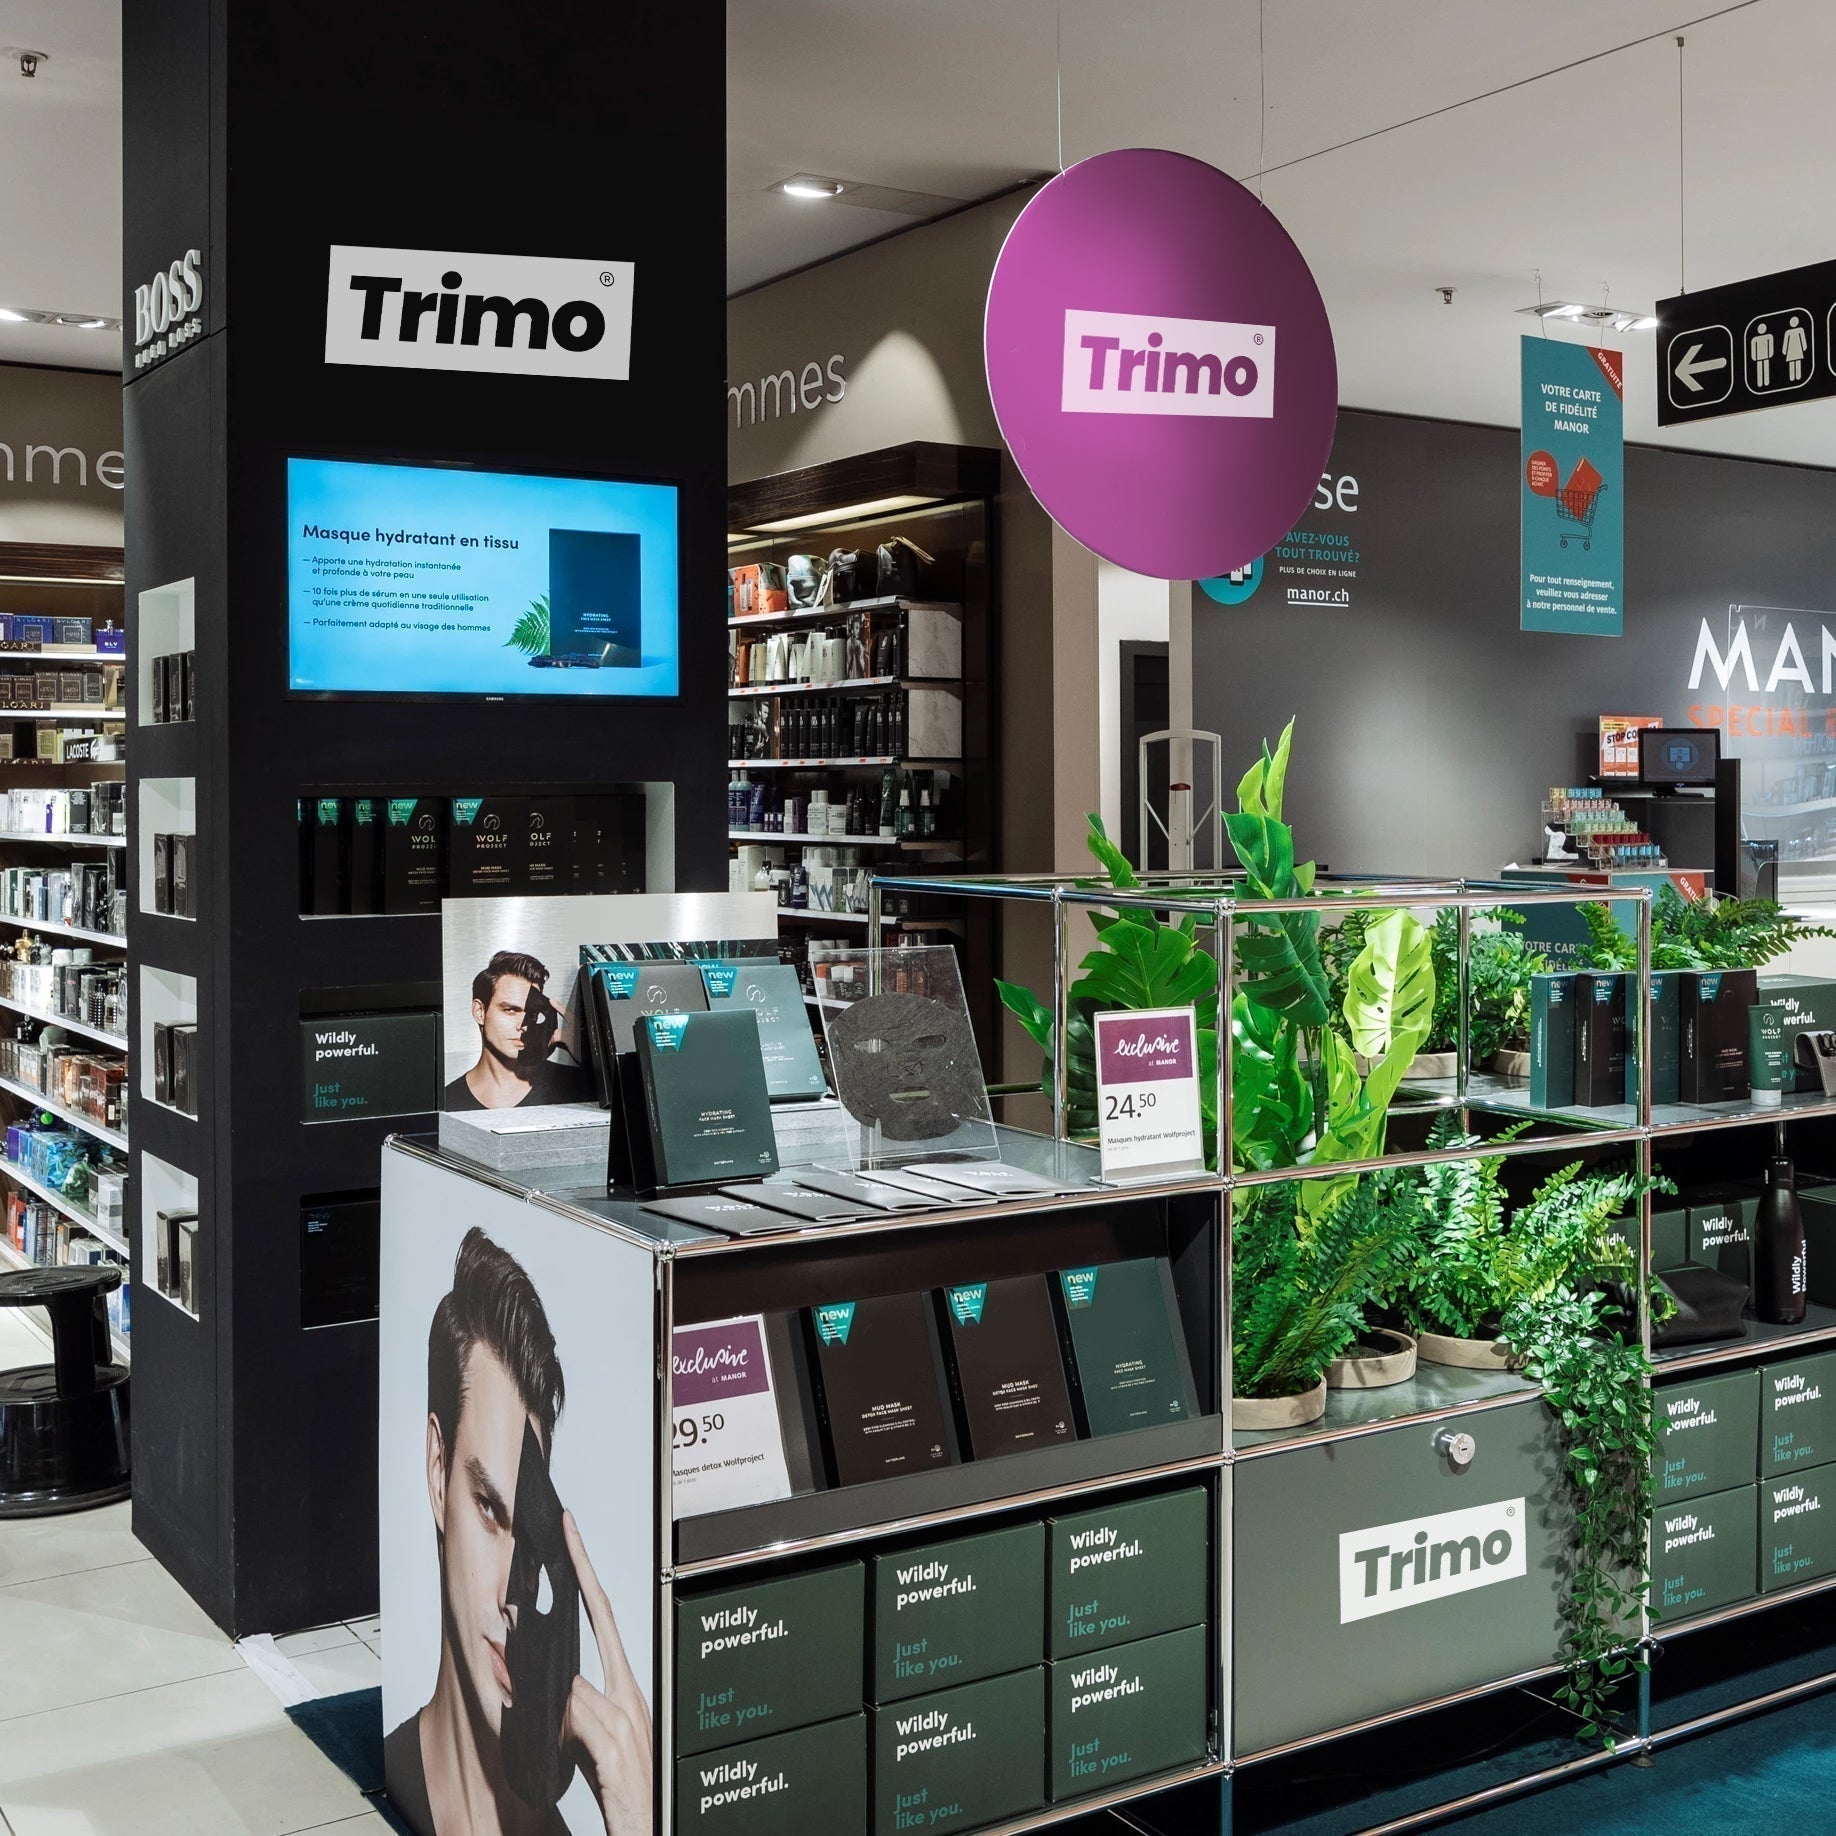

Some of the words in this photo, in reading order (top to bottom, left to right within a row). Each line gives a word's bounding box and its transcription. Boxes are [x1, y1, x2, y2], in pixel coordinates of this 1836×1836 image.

[135, 249, 202, 346] BOSS
[350, 270, 605, 353] Trimo
[1081, 332, 1258, 396] Trimo
[1597, 352, 1623, 389] GRATUITE
[1541, 383, 1571, 398] VOTRE
[1573, 388, 1602, 402] CARTE
[1545, 401, 1558, 413] DE
[1560, 403, 1598, 419] FIDÉLITÉ
[1554, 419, 1589, 434] MANOR
[303, 524, 371, 545] Masque
[375, 528, 456, 546] hydratant
[460, 537, 479, 547] en
[484, 535, 519, 549] tissu
[1286, 532, 1350, 547] AVEZ-VOUS
[311, 556, 346, 566] Apporte
[366, 558, 412, 569] hydratation
[414, 561, 461, 571] instantanée
[1275, 547, 1306, 559] TOUT
[1308, 549, 1360, 563] TROUVÉ?
[312, 567, 320, 575] et
[322, 567, 361, 577] profonde
[363, 568, 369, 577] à
[370, 570, 391, 578] votre
[1307, 568, 1326, 576] CHOIX
[1530, 574, 1546, 583] Pour
[1547, 576, 1562, 584] tout
[1563, 578, 1615, 590] renseignement,
[312, 587, 321, 596] 10
[323, 587, 338, 596] fois
[340, 588, 357, 598] plus
[359, 589, 370, 597] de
[371, 590, 398, 599] sérum
[411, 592, 427, 600] une
[428, 592, 450, 600] seule
[451, 593, 489, 602] utilisation
[1287, 588, 1350, 602] manor.ch
[1536, 588, 1562, 597] veuillez
[1564, 591, 1579, 599] vous
[1581, 591, 1608, 601] adresser
[312, 598, 342, 607] qu'une
[343, 599, 369, 608] crème
[371, 601, 420, 610] quotidienne
[421, 602, 474, 612] traditionnelle
[1527, 599, 1531, 608] à
[1532, 601, 1551, 609] notre
[1552, 602, 1585, 612] personnel
[1586, 604, 1595, 613] de
[1597, 606, 1617, 614] vente.
[312, 618, 367, 628] Parfaitement
[368, 620, 399, 631] adapté
[400, 622, 411, 630] au
[413, 622, 440, 632] visage
[441, 623, 456, 631] des
[457, 623, 491, 632] hommes
[1687, 704, 1813, 737] SPECIAL
[1607, 730, 1626, 744] STOP
[66, 743, 89, 759] LACOSTE
[391, 802, 413, 810] new
[475, 834, 508, 843] WOLF
[607, 971, 635, 980] new
[708, 971, 733, 980] new
[1701, 978, 1718, 986] new
[653, 1018, 685, 1030] new
[1783, 1011, 1816, 1026] werful.
[315, 1031, 357, 1046] Wildly
[1114, 1033, 1180, 1058] exclusive
[315, 1043, 379, 1061] powerful.
[1156, 1058, 1177, 1066] MANOR
[313, 1082, 341, 1097] Just
[314, 1095, 338, 1109] like
[340, 1096, 369, 1110] you.
[1105, 1092, 1157, 1120] 24.50
[1107, 1136, 1133, 1145] Masques
[1133, 1132, 1162, 1142] hydratant
[1163, 1129, 1196, 1140] Wolfproject
[1702, 1216, 1733, 1232] Wildly
[1702, 1228, 1749, 1250] powerful.
[1067, 1272, 1094, 1284] new
[1792, 1256, 1802, 1294] Wildly
[954, 1289, 982, 1302] new
[819, 1308, 849, 1321] new
[672, 1345, 749, 1375] exclusive
[1115, 1360, 1143, 1369] HYDRATING
[720, 1371, 747, 1382] MANOR
[1774, 1374, 1805, 1392] Wildly
[886, 1402, 901, 1410] MASK
[1666, 1398, 1700, 1416] Wildly
[1774, 1386, 1821, 1411] powerful.
[1666, 1410, 1717, 1436] powerful.
[1773, 1432, 1793, 1451] Just
[701, 1461, 723, 1472] detox
[723, 1453, 765, 1468] Wolfproject
[1774, 1449, 1791, 1462] like
[1793, 1445, 1813, 1458] you.
[1663, 1457, 1686, 1477] Just
[1664, 1474, 1683, 1488] like
[1685, 1472, 1706, 1485] you.
[1773, 1485, 1804, 1504] Wildly
[1773, 1496, 1821, 1523] powerful.
[1665, 1515, 1698, 1533] Wildly
[1070, 1527, 1117, 1552] Wildly
[1665, 1525, 1715, 1553] powerful.
[1070, 1540, 1143, 1574] powerful.
[1354, 1529, 1512, 1598] Trimo
[896, 1561, 949, 1588] Wildly
[896, 1574, 976, 1611] powerful.
[1663, 1574, 1684, 1594] Just
[1663, 1591, 1682, 1607] like
[1684, 1588, 1706, 1602] you.
[700, 1606, 758, 1632] Wildly
[1066, 1599, 1099, 1624] Just
[1068, 1619, 1097, 1638] like
[1099, 1615, 1131, 1636] you.
[700, 1623, 789, 1659] powerful.
[893, 1637, 928, 1664] Just
[895, 1659, 925, 1679] like
[928, 1654, 963, 1677] you.
[1070, 1665, 1118, 1690] Wildly
[697, 1687, 735, 1716] Just
[1070, 1678, 1144, 1712] powerful.
[698, 1710, 732, 1731] like
[735, 1704, 773, 1727] you.
[896, 1711, 948, 1737] Wildly
[896, 1724, 977, 1761] powerful.
[700, 1760, 758, 1787] Wildly
[700, 1778, 789, 1815] powerful.
